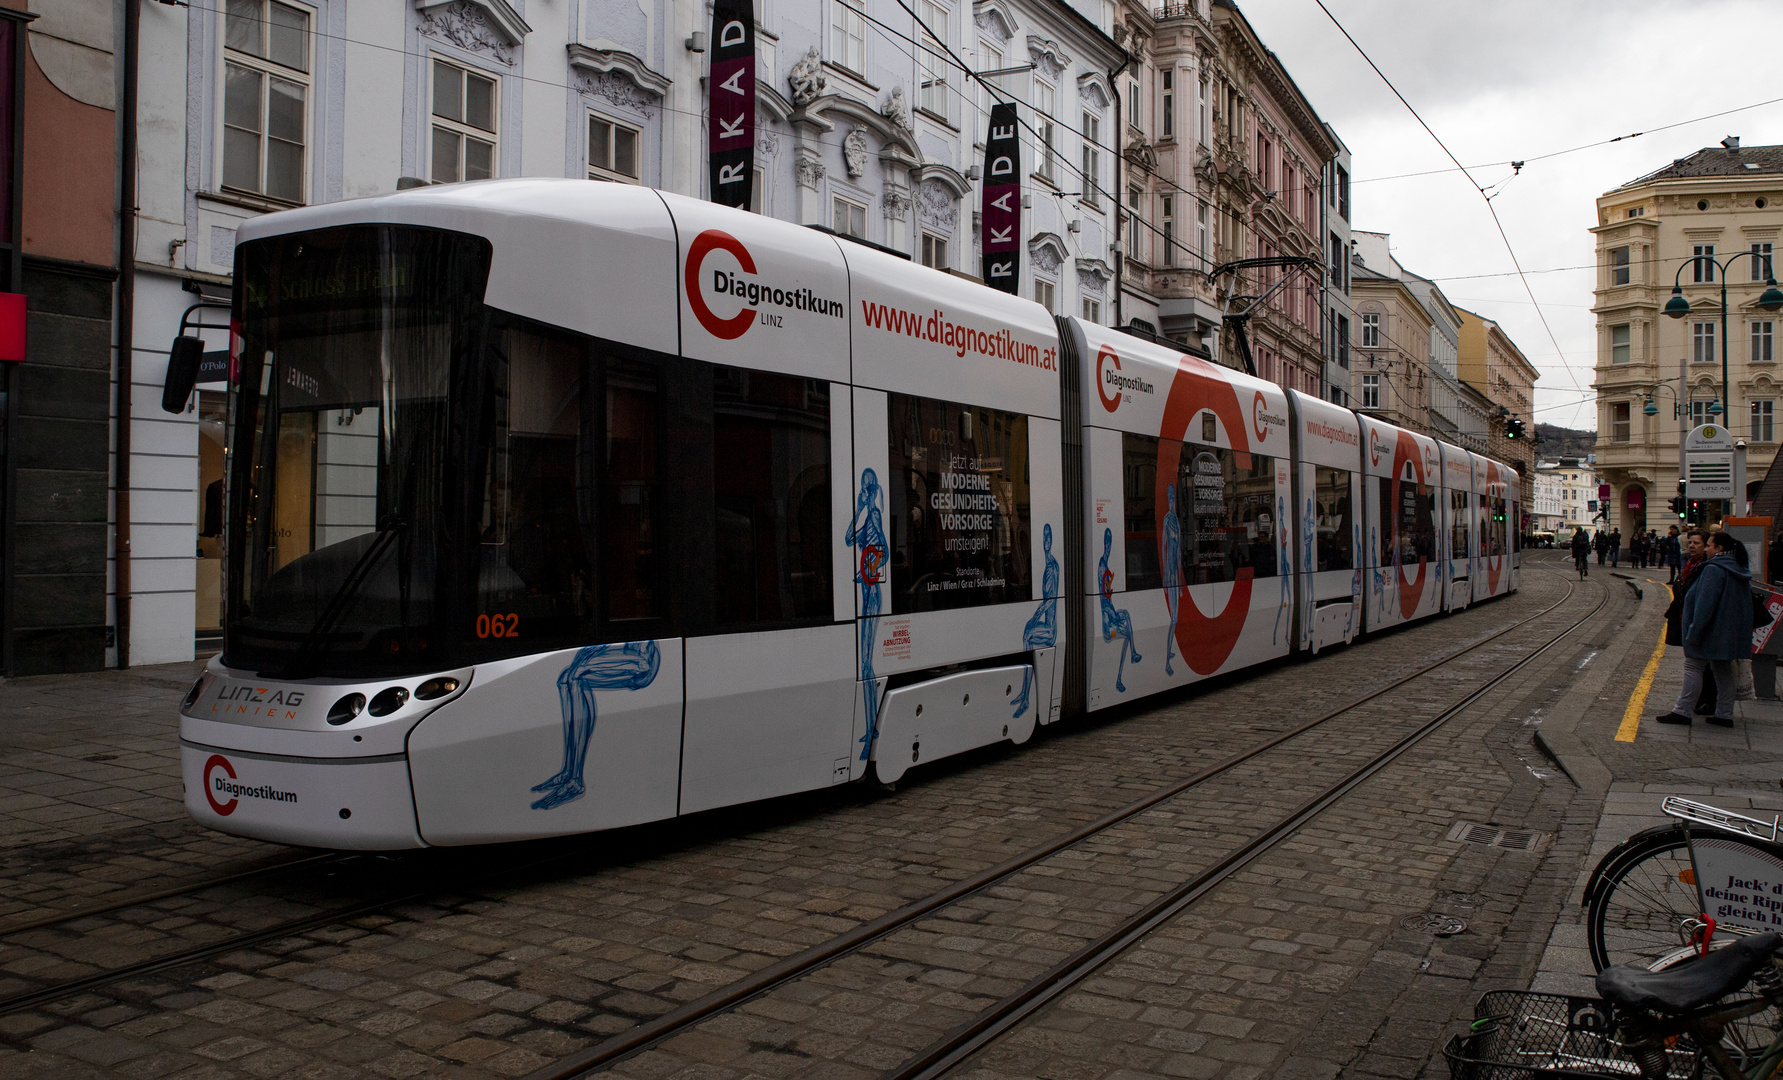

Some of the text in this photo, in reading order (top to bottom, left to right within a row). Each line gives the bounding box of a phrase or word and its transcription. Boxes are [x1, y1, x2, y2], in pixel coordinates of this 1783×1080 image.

[713, 270, 844, 318] Diagnostikum
[761, 312, 783, 328] LINZ
[861, 300, 1057, 372] www.diagnostikum.at
[1106, 369, 1154, 395] Diagnostikum
[1306, 420, 1358, 447] www.diagnostikum.at
[949, 452, 983, 471] Jetzt auf
[1199, 461, 1222, 474] MODERNE
[941, 472, 990, 490] MODERNE
[930, 492, 1000, 511] GESUNDHEITS-
[940, 513, 993, 531] VORSORGE
[944, 534, 989, 554] umsteigen!
[956, 566, 980, 577] Standorte
[927, 581, 939, 591] Linz
[943, 580, 957, 590] Wien
[961, 579, 973, 589] Graz
[977, 577, 1005, 587] Schladming
[475, 612, 520, 639] 062
[217, 685, 305, 707] LINZ AG
[211, 703, 298, 720] LINIEN
[215, 777, 298, 803] Diagnostikum
[1705, 887, 1748, 903] deine
[1717, 905, 1766, 922] gleich
